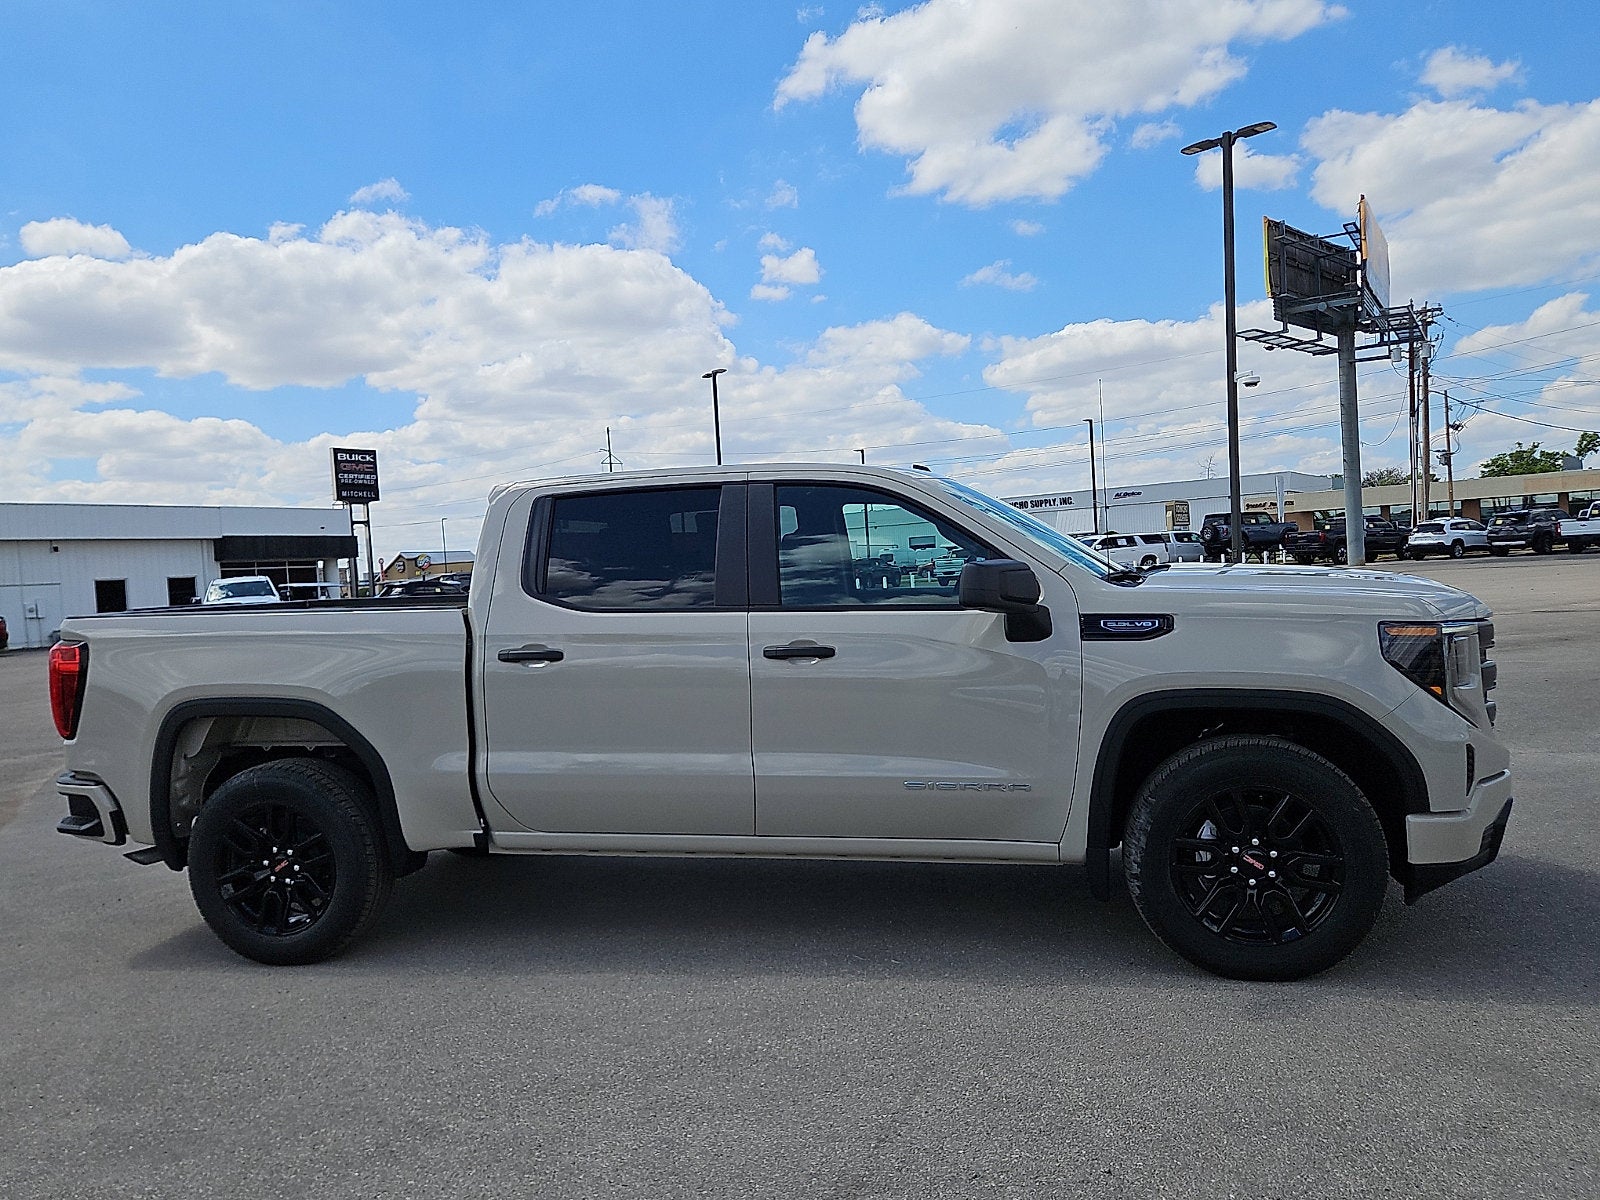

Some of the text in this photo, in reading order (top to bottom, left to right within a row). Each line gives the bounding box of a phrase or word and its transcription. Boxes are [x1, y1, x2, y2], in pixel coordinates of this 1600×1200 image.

[337, 453, 375, 462] BUICK
[339, 462, 374, 472] GMC
[341, 490, 376, 498] MITCHELL
[1030, 498, 1059, 509] SUPPLY,
[1059, 496, 1075, 506] INC.
[903, 780, 1032, 792] SIERRA
